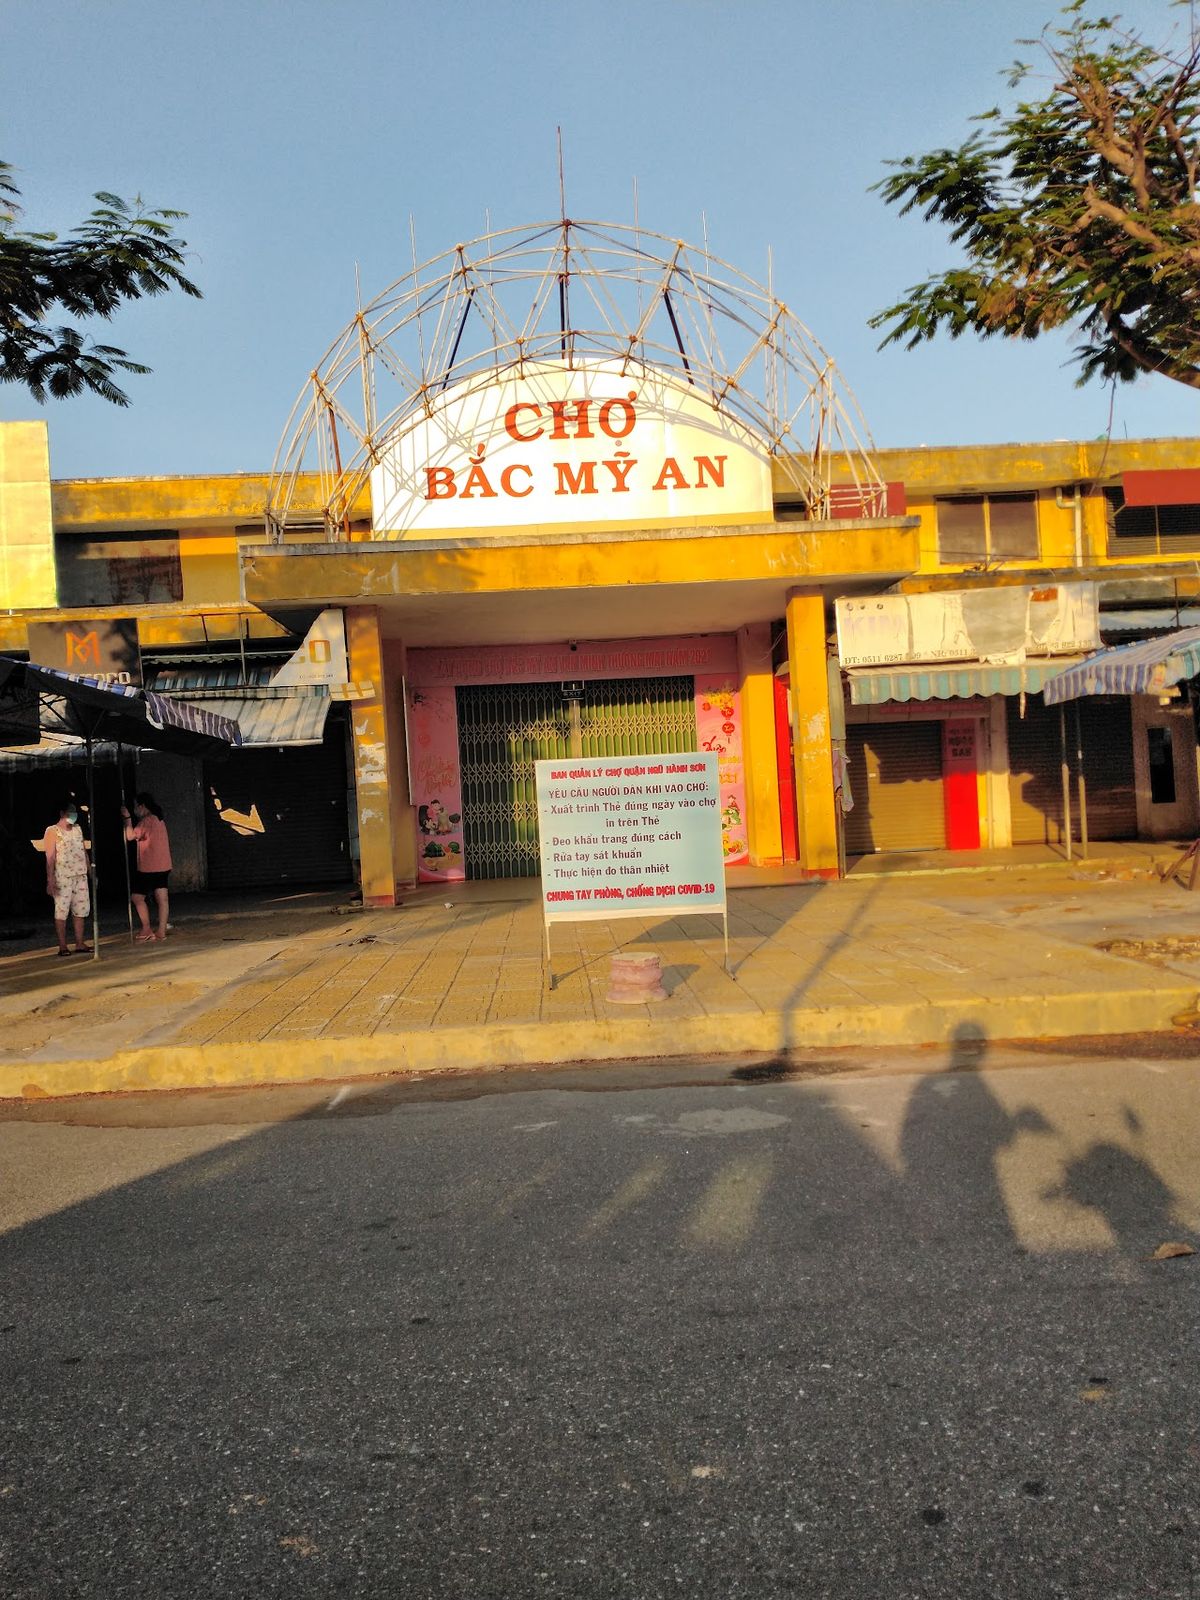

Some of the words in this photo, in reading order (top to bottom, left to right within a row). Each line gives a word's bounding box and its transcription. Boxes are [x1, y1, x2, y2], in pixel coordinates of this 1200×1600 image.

[504, 391, 637, 447] CHỢ
[422, 443, 534, 501] BẮC
[554, 451, 638, 496] MỸ
[652, 455, 729, 491] AN
[551, 770, 567, 780] BAN
[569, 767, 591, 780] QUẢN
[593, 767, 603, 778] LÝ
[605, 767, 622, 778] CHỢ
[624, 765, 646, 777] QUẬN
[666, 763, 688, 774] HÀNH
[690, 762, 706, 773] SƠN
[548, 787, 567, 799] YÊU
[570, 785, 589, 798] CẦU
[592, 784, 620, 797] NGƯỜI
[623, 783, 643, 795] DÂN
[646, 784, 662, 794] KHI
[686, 781, 709, 793] CHỢ:
[550, 801, 573, 814] Xuất
[603, 799, 621, 812] Thẻ
[625, 799, 649, 812] đúng
[652, 798, 675, 811] ngày
[678, 796, 696, 808] vào
[698, 796, 716, 808] chợ
[606, 818, 615, 828] in
[618, 816, 639, 827] trên
[641, 815, 660, 826] Thẻ
[552, 837, 571, 847] Đeo
[574, 832, 599, 846] khẩu
[601, 834, 628, 845] trang
[631, 832, 655, 843] đúng
[658, 830, 682, 841] cách
[553, 851, 573, 863] Rửa
[575, 851, 590, 863] tay
[593, 849, 609, 861] sát
[612, 847, 642, 859] khuẩn
[554, 868, 578, 879] Thực
[581, 867, 602, 878] hiện
[605, 865, 617, 876] đo
[620, 864, 642, 875] thân
[645, 863, 670, 875] nhiệt
[546, 890, 574, 902] CHUNG
[576, 890, 592, 900] TAY
[594, 887, 624, 900] PHÒNG,
[625, 884, 655, 898] CHỐNG
[656, 884, 676, 898] DỊCH
[677, 883, 716, 895] COVID-19
